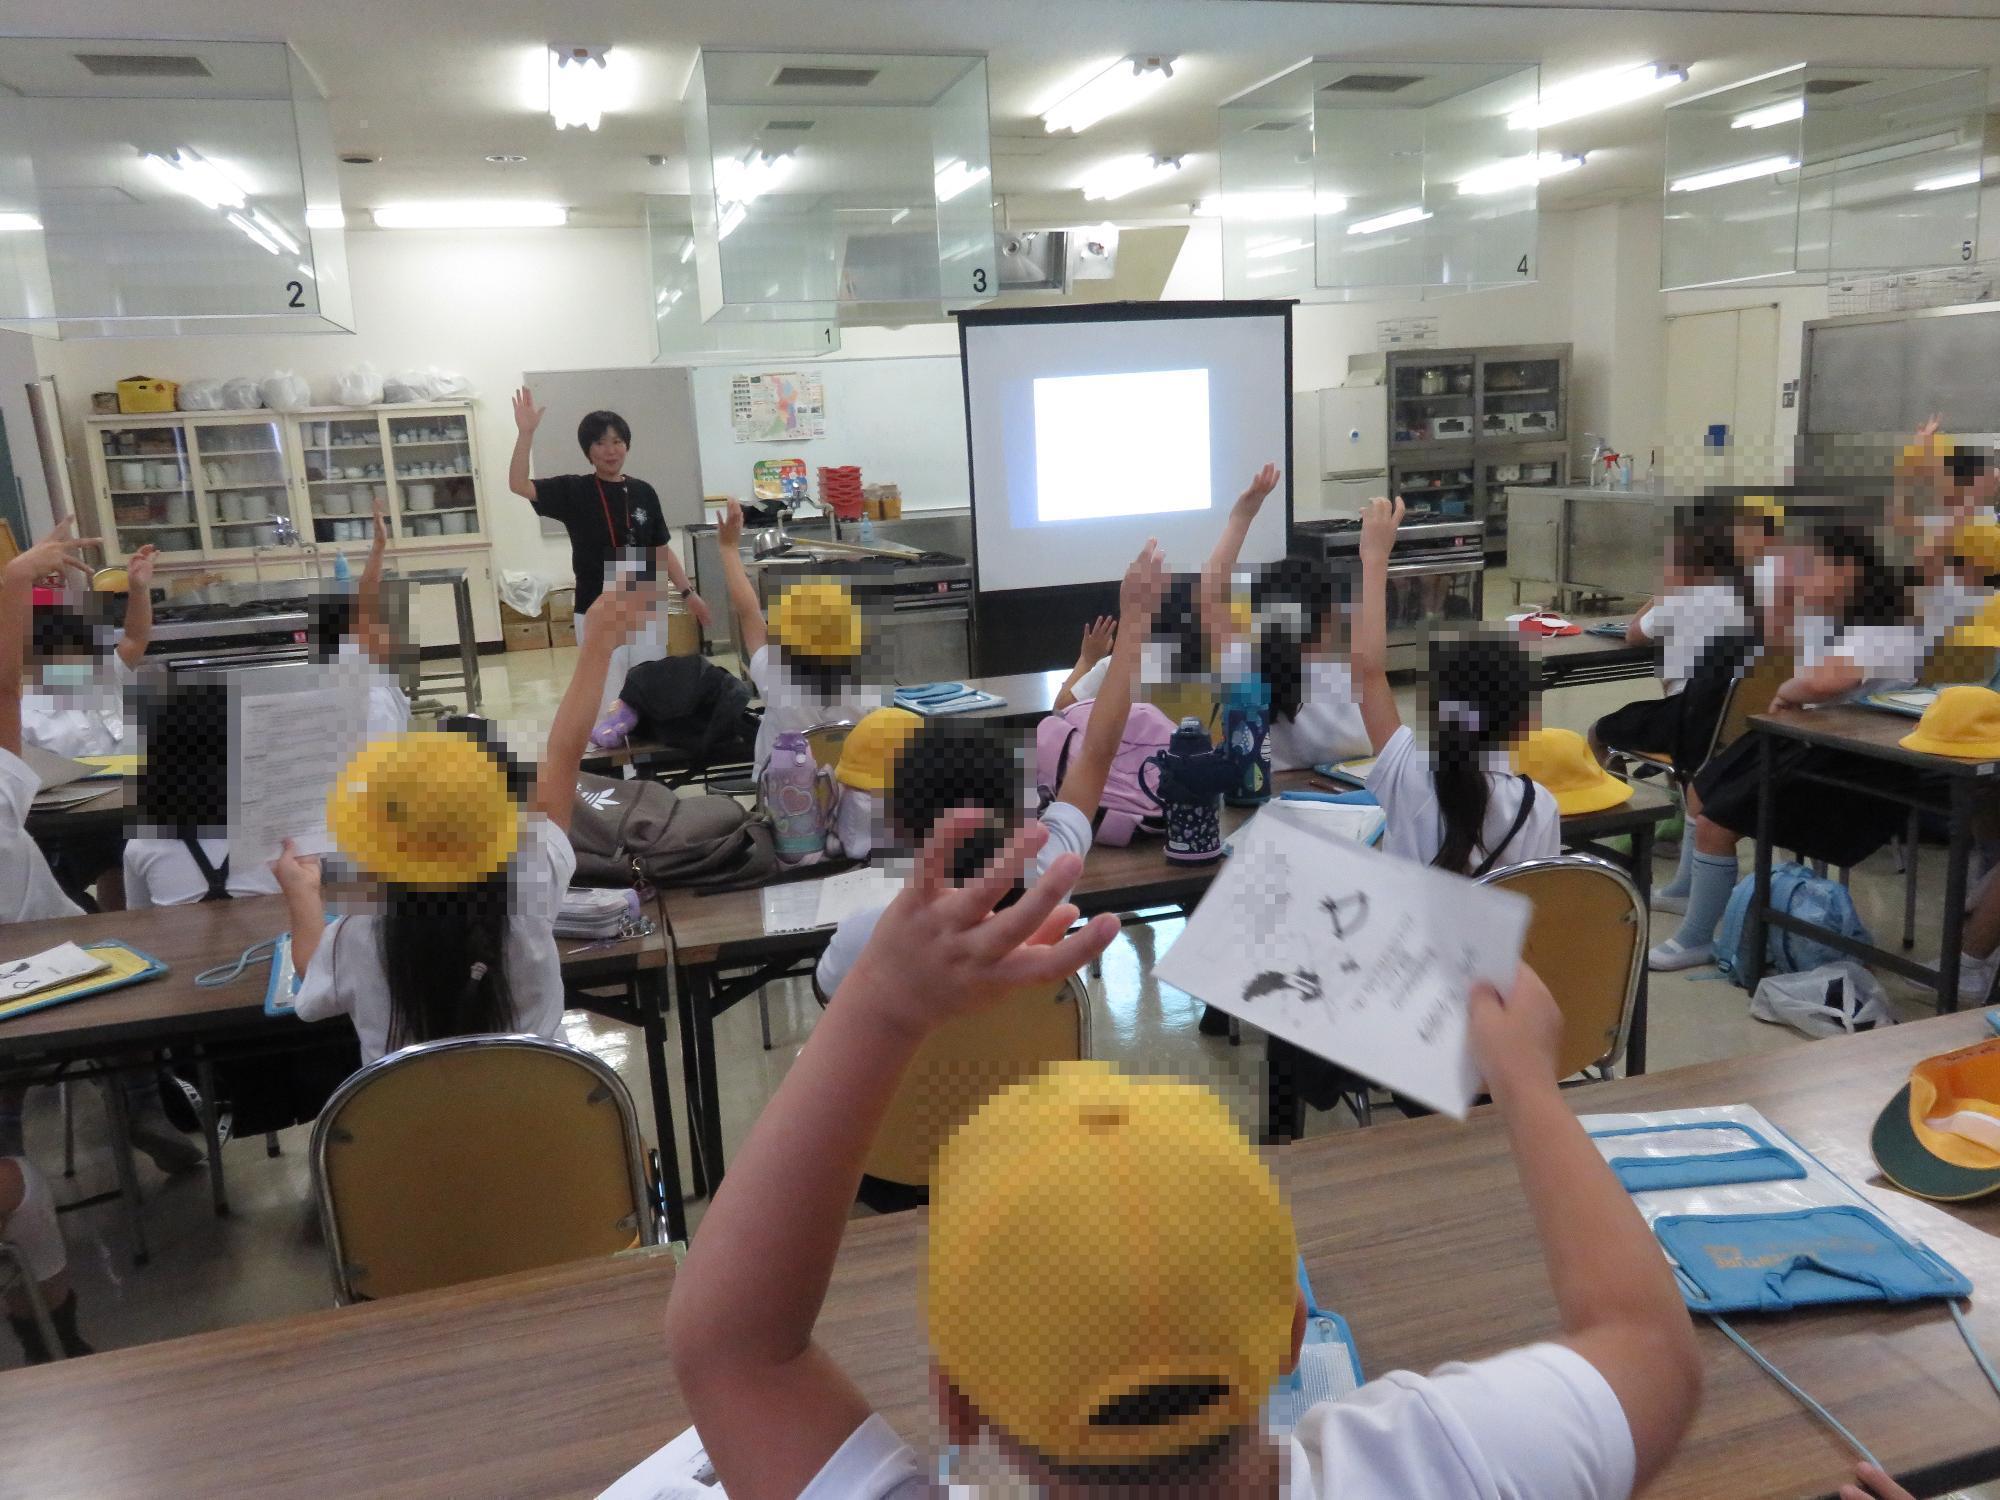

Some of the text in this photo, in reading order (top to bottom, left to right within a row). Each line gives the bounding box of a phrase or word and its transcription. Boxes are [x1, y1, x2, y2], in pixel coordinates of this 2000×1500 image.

[1961, 240, 1973, 261] 5
[1516, 254, 1529, 276] 4
[972, 268, 987, 293] 3
[286, 280, 306, 308] 2
[824, 328, 832, 345] 1
